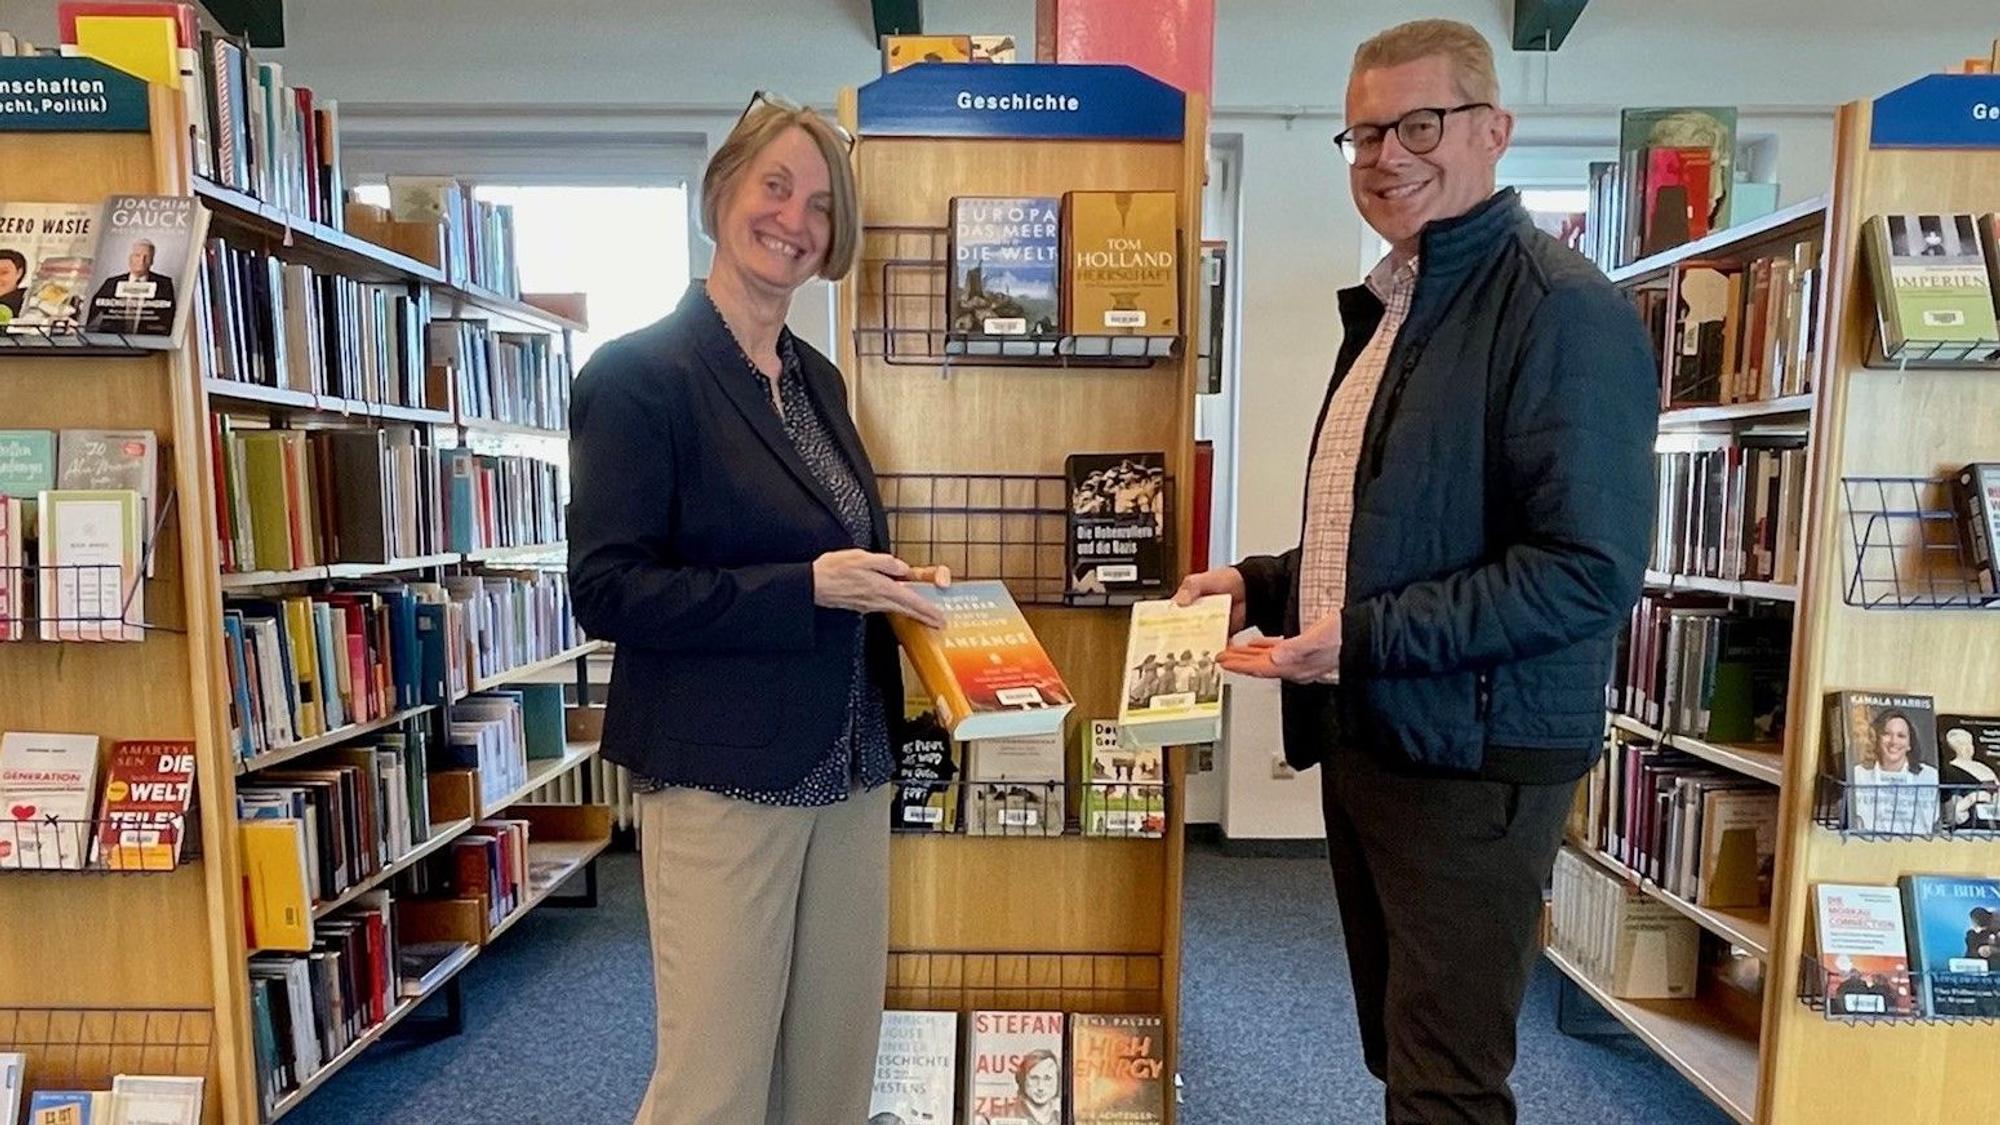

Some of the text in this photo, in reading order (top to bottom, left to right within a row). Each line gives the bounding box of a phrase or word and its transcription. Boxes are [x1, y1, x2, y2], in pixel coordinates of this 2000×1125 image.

[41, 96, 107, 113] Politik)
[957, 91, 1080, 111] Geschichte
[117, 198, 191, 210] JOACHIM
[112, 210, 187, 228] GAUCK
[957, 207, 1056, 223] EUROPA
[0, 218, 91, 234] ZERO WASTE
[957, 223, 1056, 238] DAS MEER
[1106, 238, 1142, 250] TOM
[957, 246, 1056, 261] DIE WELT
[1077, 252, 1173, 267] HOLLAND
[1078, 268, 1170, 281] HERRSCHAFT
[1895, 275, 1987, 289] IMPERIEN
[1850, 695, 1931, 709] KAMALA HARRIS
[158, 754, 194, 773] DIE
[3, 772, 81, 783] GENERATION
[130, 782, 189, 802] WELT
[1922, 881, 1947, 899] JOE
[976, 1014, 1061, 1034] STEFAN
[878, 1054, 949, 1068] ESCHICHTE
